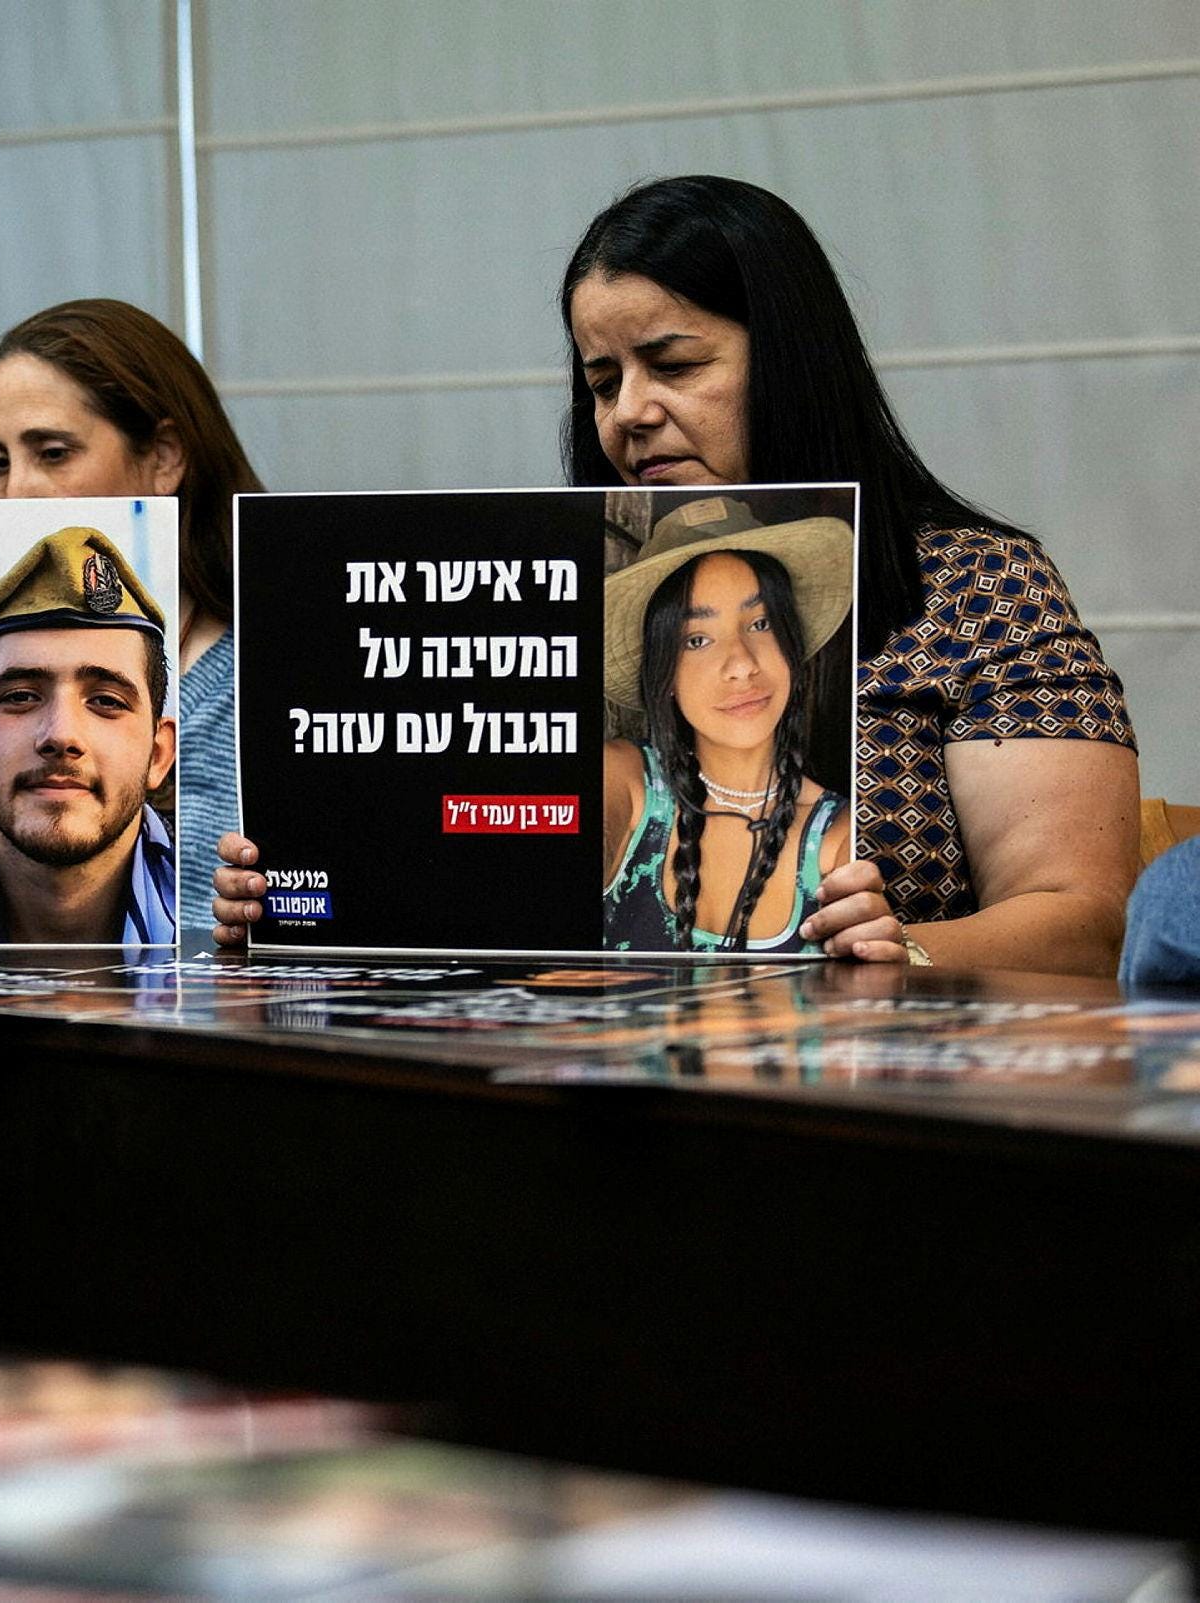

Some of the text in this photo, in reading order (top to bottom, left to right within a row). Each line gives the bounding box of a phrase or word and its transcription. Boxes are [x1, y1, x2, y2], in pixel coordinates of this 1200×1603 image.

[345, 559, 578, 603] מי אישר את
[359, 627, 578, 678] המסיבה על
[289, 702, 578, 754] הגבול עם עזה?
[447, 799, 575, 830] שני בן עמי ז"ל
[265, 869, 329, 891] מועצת
[268, 896, 326, 916] אוקטובר
